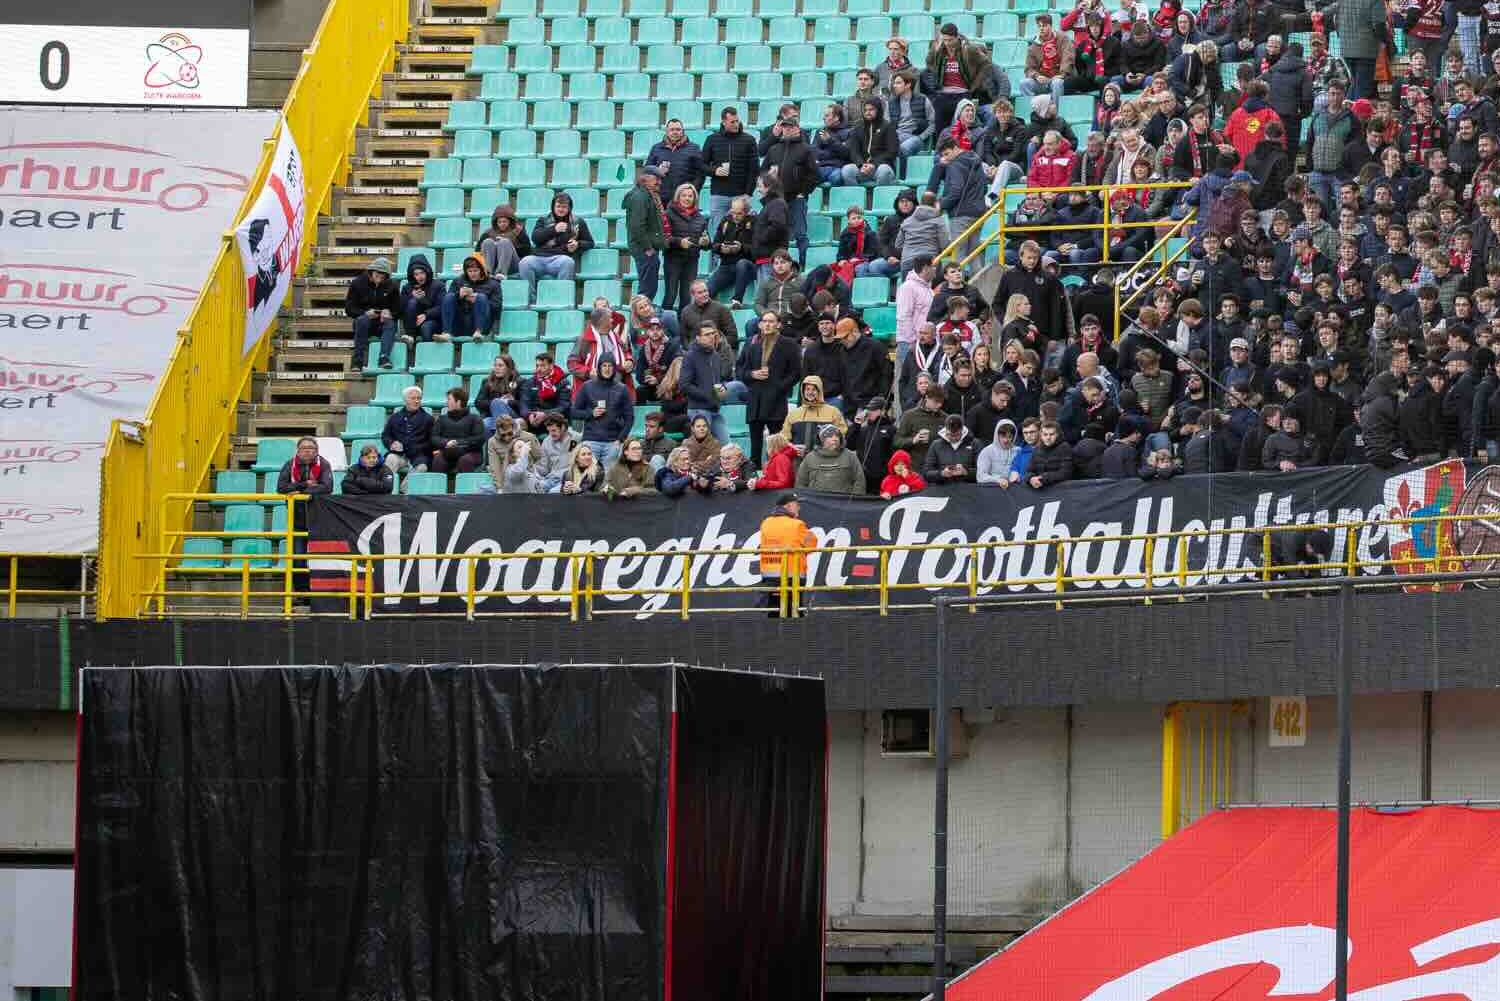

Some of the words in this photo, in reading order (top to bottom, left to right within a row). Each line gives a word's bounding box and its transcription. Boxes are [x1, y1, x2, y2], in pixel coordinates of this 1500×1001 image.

[39, 40, 70, 91] 0
[0, 207, 126, 230] aert
[879, 492, 1386, 595] Footballculre
[1274, 702, 1303, 737] 412
